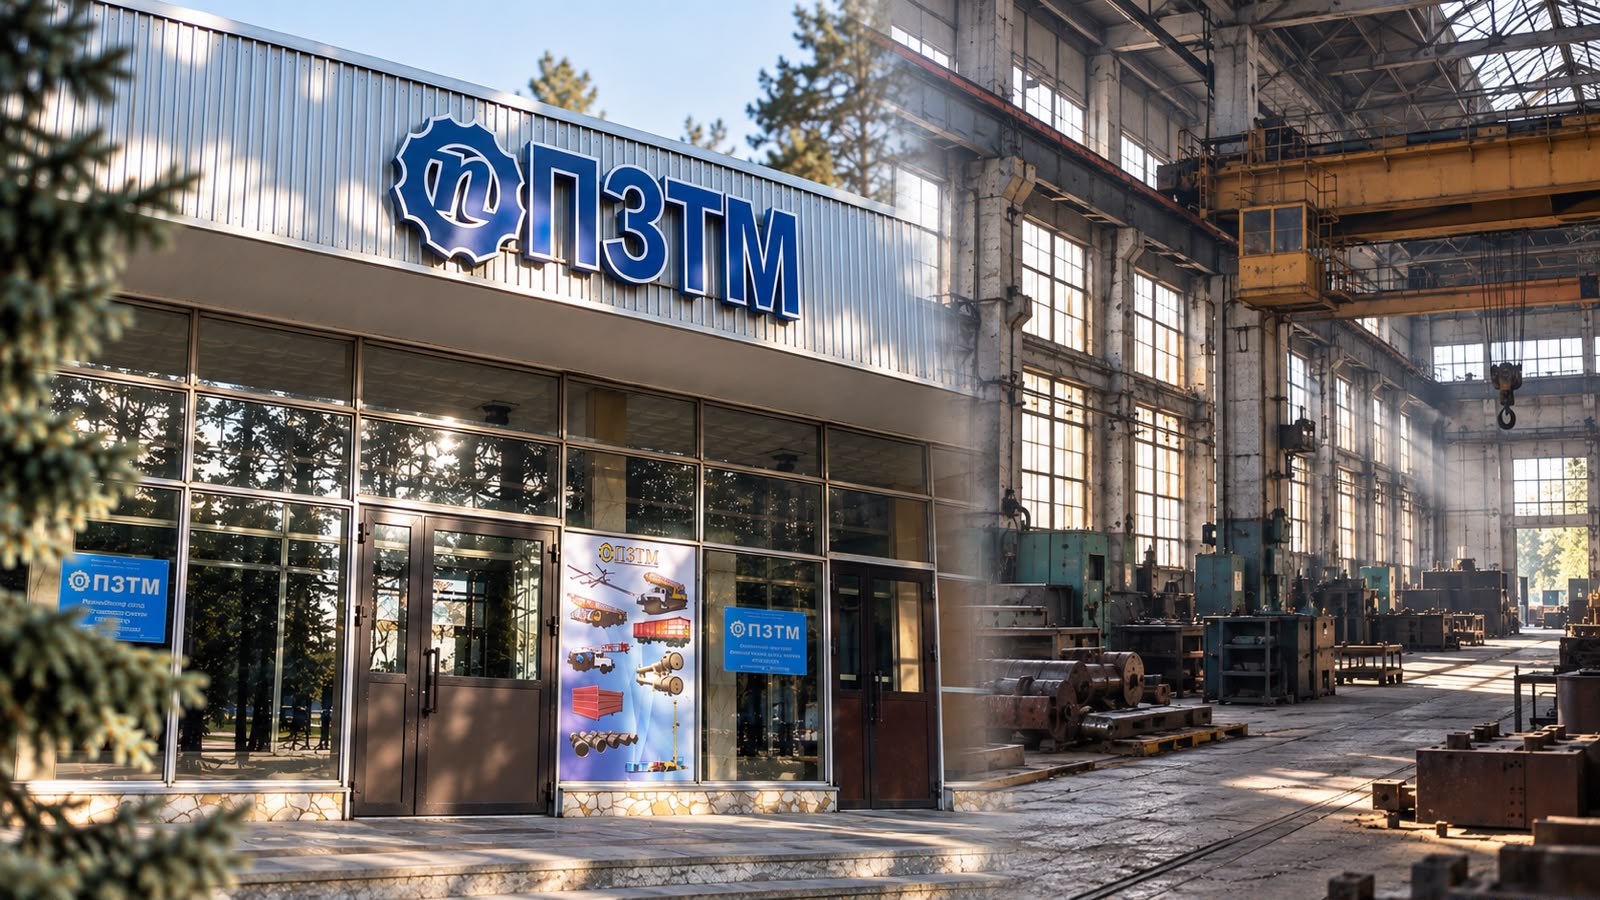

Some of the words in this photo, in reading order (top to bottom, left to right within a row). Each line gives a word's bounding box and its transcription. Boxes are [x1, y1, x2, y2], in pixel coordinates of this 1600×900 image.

[524, 140, 801, 322] ПЗТМ
[614, 545, 659, 565] ПЗТМ
[93, 574, 160, 595] ПЗТМ
[748, 623, 800, 640] ПЗТМ
